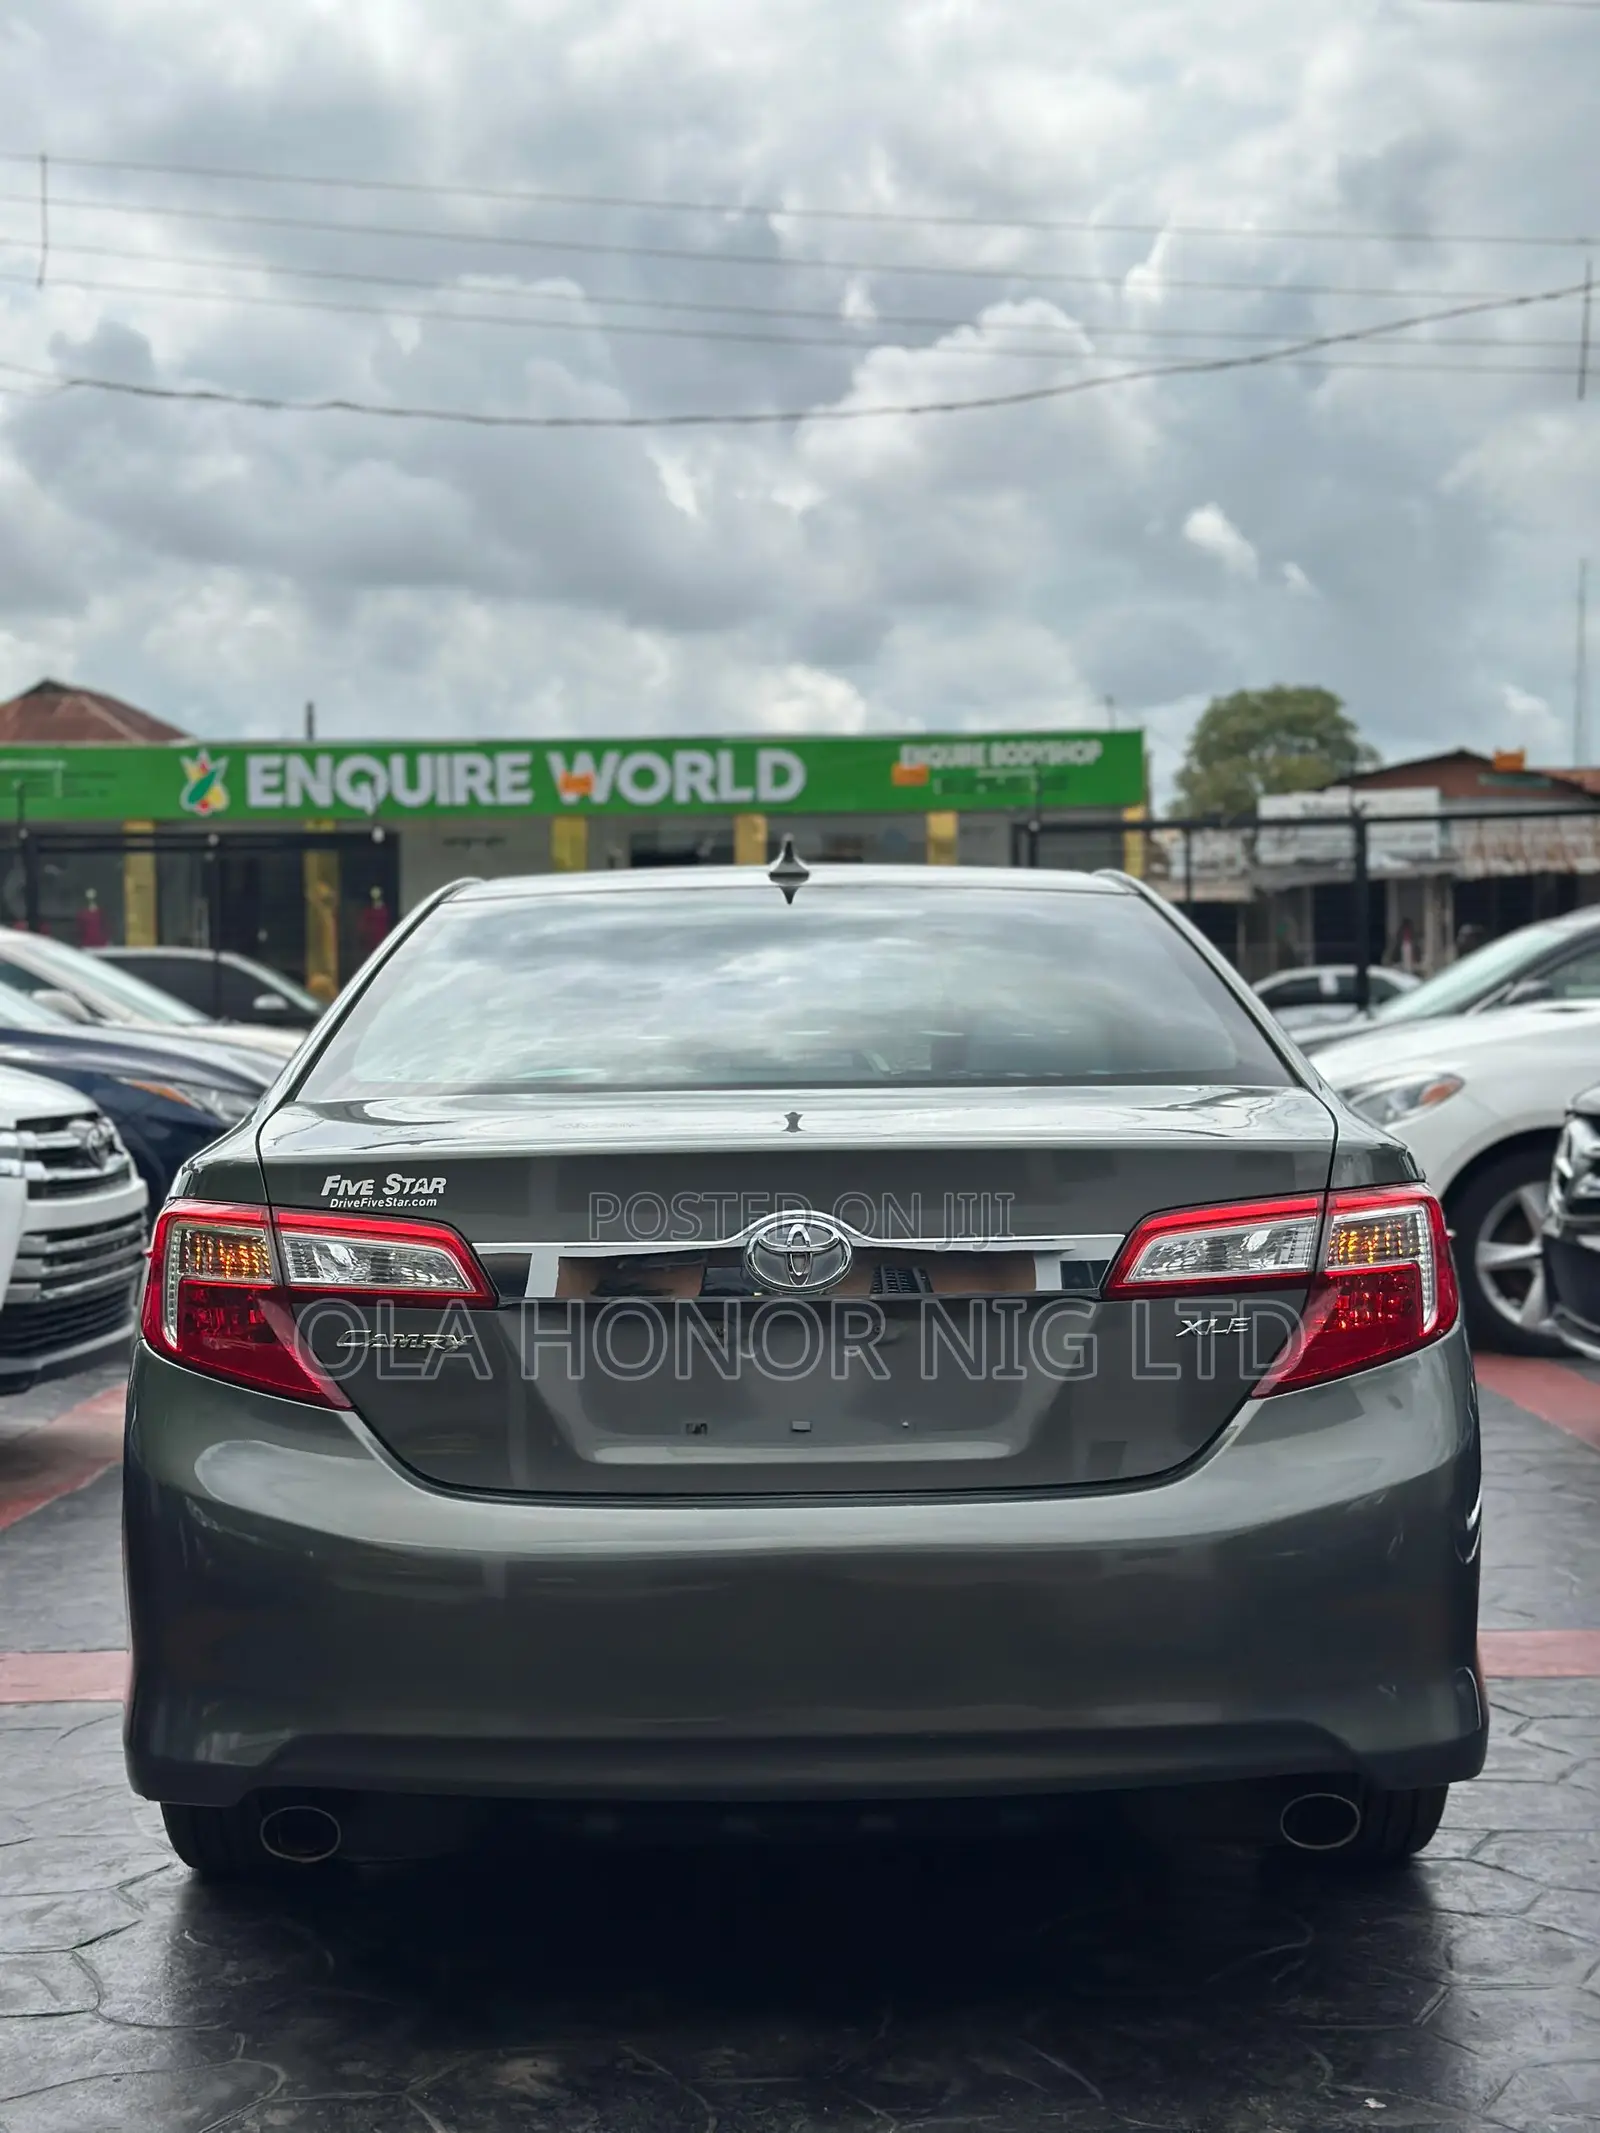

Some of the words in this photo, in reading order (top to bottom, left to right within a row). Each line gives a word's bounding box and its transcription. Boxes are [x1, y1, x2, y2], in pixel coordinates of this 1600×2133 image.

[246, 752, 533, 815] ENQUIRE
[548, 749, 806, 806] WORLD
[329, 1196, 438, 1209] DriveFiveStar.com
[1175, 1317, 1252, 1338] XLE
[335, 1329, 474, 1353] CAMRY
